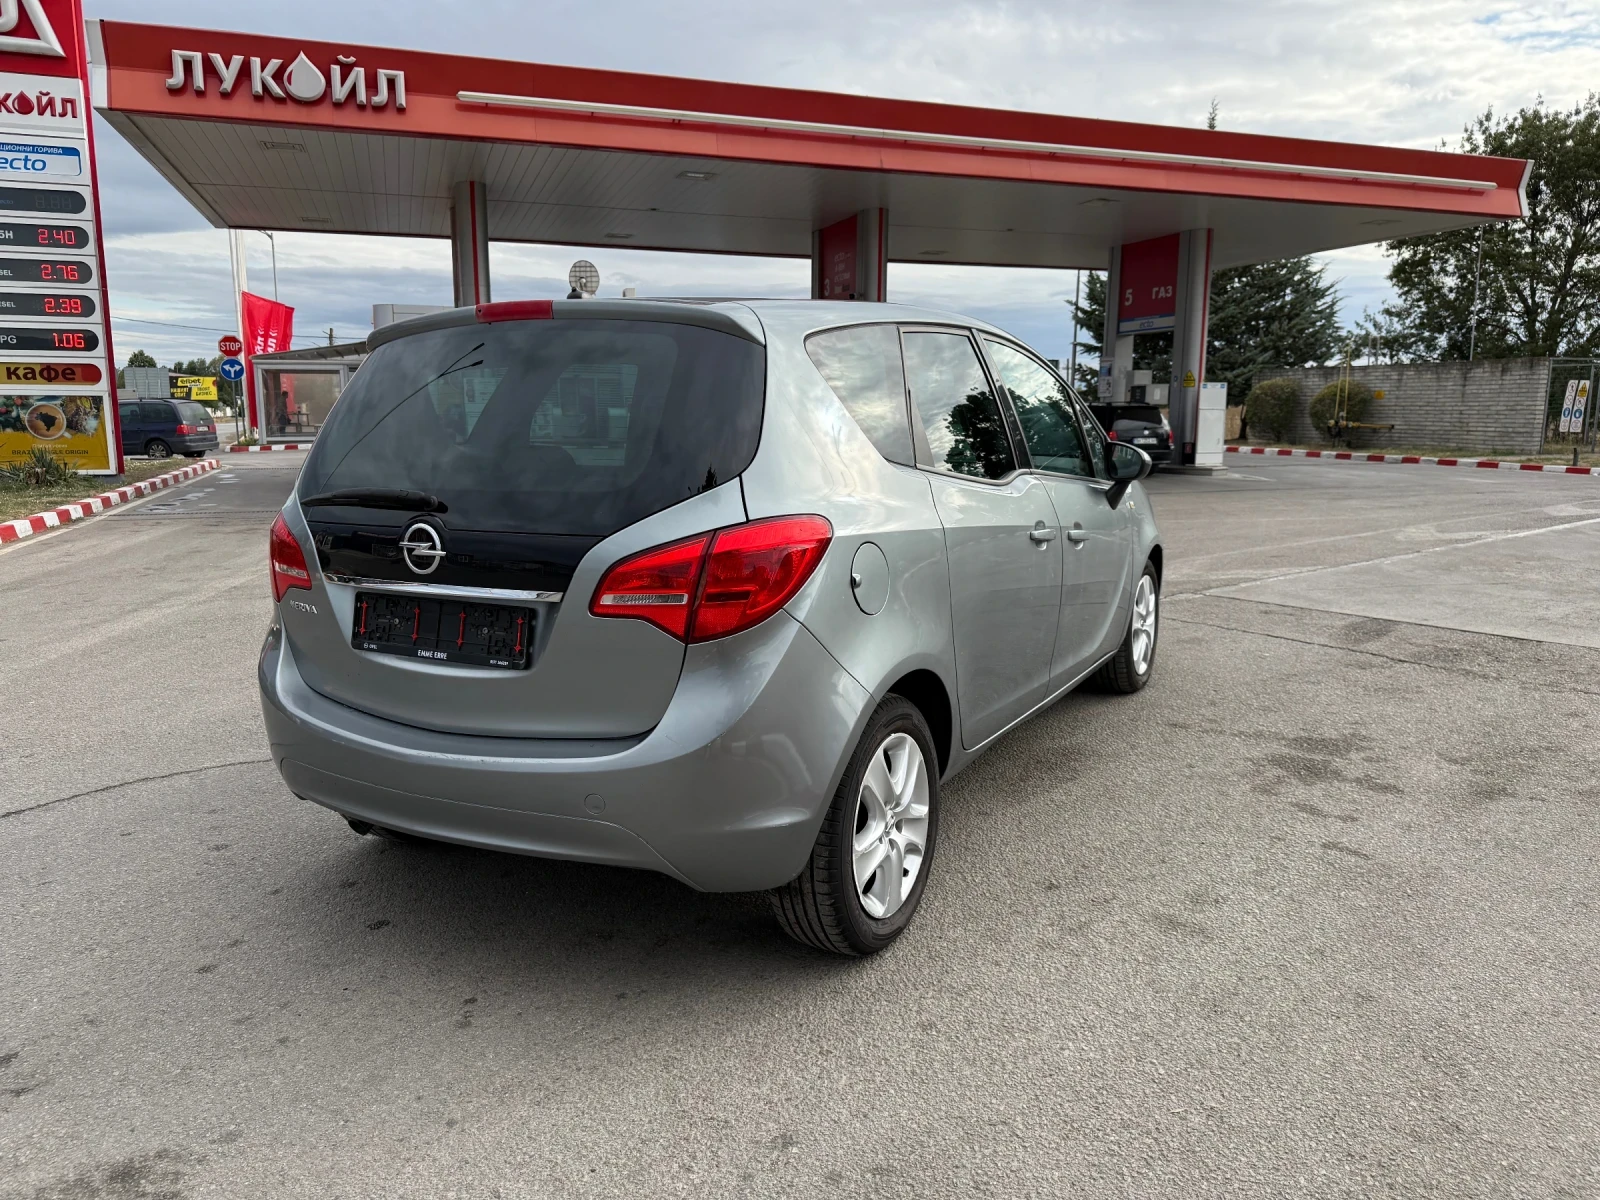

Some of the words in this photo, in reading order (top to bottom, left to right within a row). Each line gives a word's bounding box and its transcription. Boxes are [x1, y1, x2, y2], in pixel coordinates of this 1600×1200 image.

[165, 49, 406, 109] ЛУКОЙЛ
[34, 146, 63, 154] ГОРИВА
[37, 229, 75, 245] 2.40
[41, 265, 78, 280] 2.76
[1125, 288, 1133, 306] 5
[1152, 285, 1173, 300] ГАЗ
[44, 298, 82, 313] 2.39
[52, 333, 85, 348] 1.06
[220, 342, 241, 351] STOP
[5, 365, 76, 382] кафе
